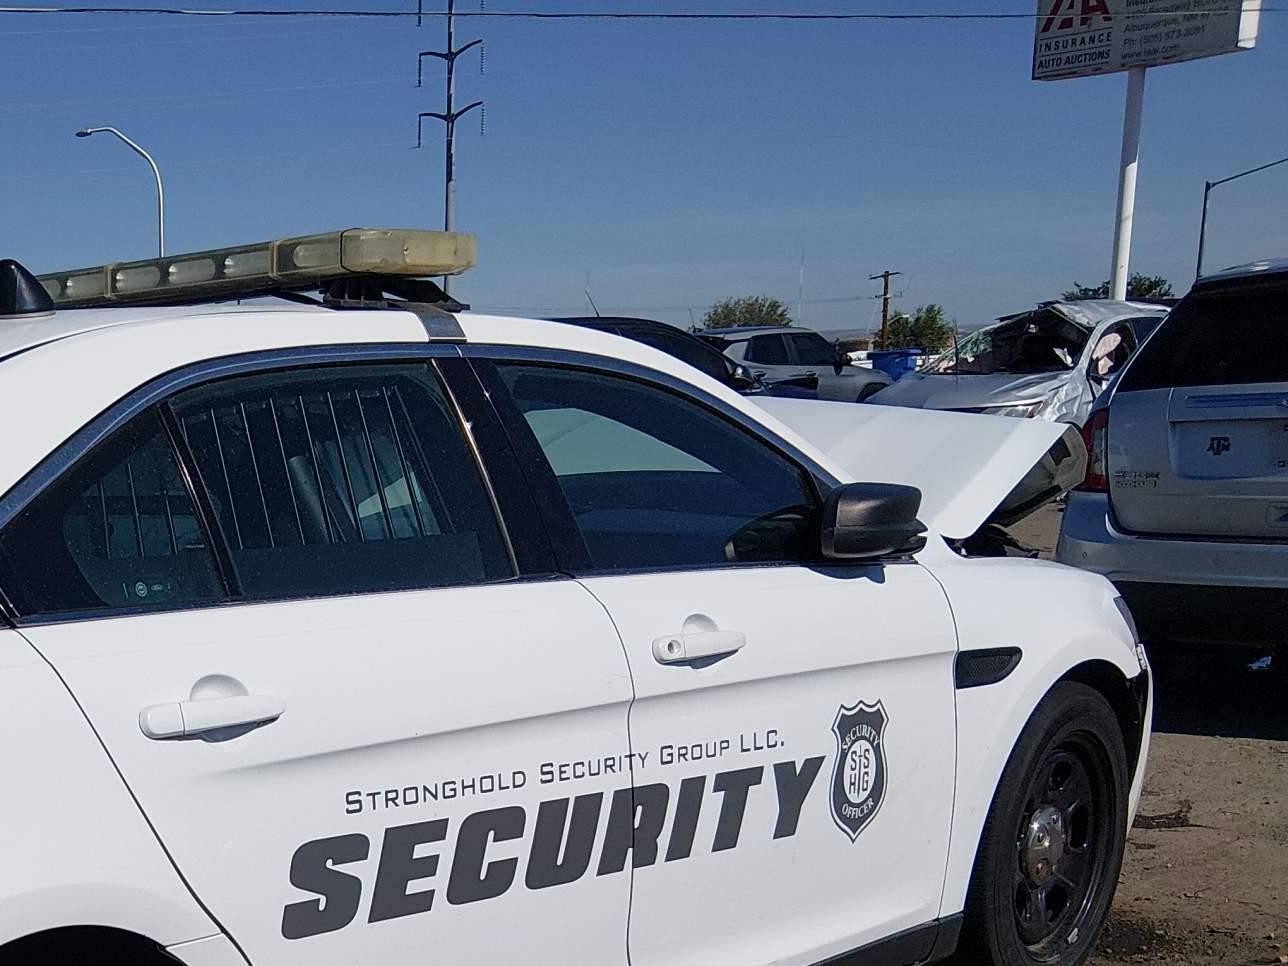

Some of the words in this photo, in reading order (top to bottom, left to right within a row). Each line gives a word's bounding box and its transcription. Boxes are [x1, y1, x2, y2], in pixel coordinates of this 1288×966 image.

[1038, 31, 1112, 53] INSURANCE
[1037, 56, 1062, 71] AUTO
[1064, 49, 1110, 66] AUCTIONS
[740, 728, 785, 754] LLC.
[841, 724, 881, 753] SECURITY
[841, 797, 875, 820] OFFICER
[281, 755, 826, 940] SECURITY
